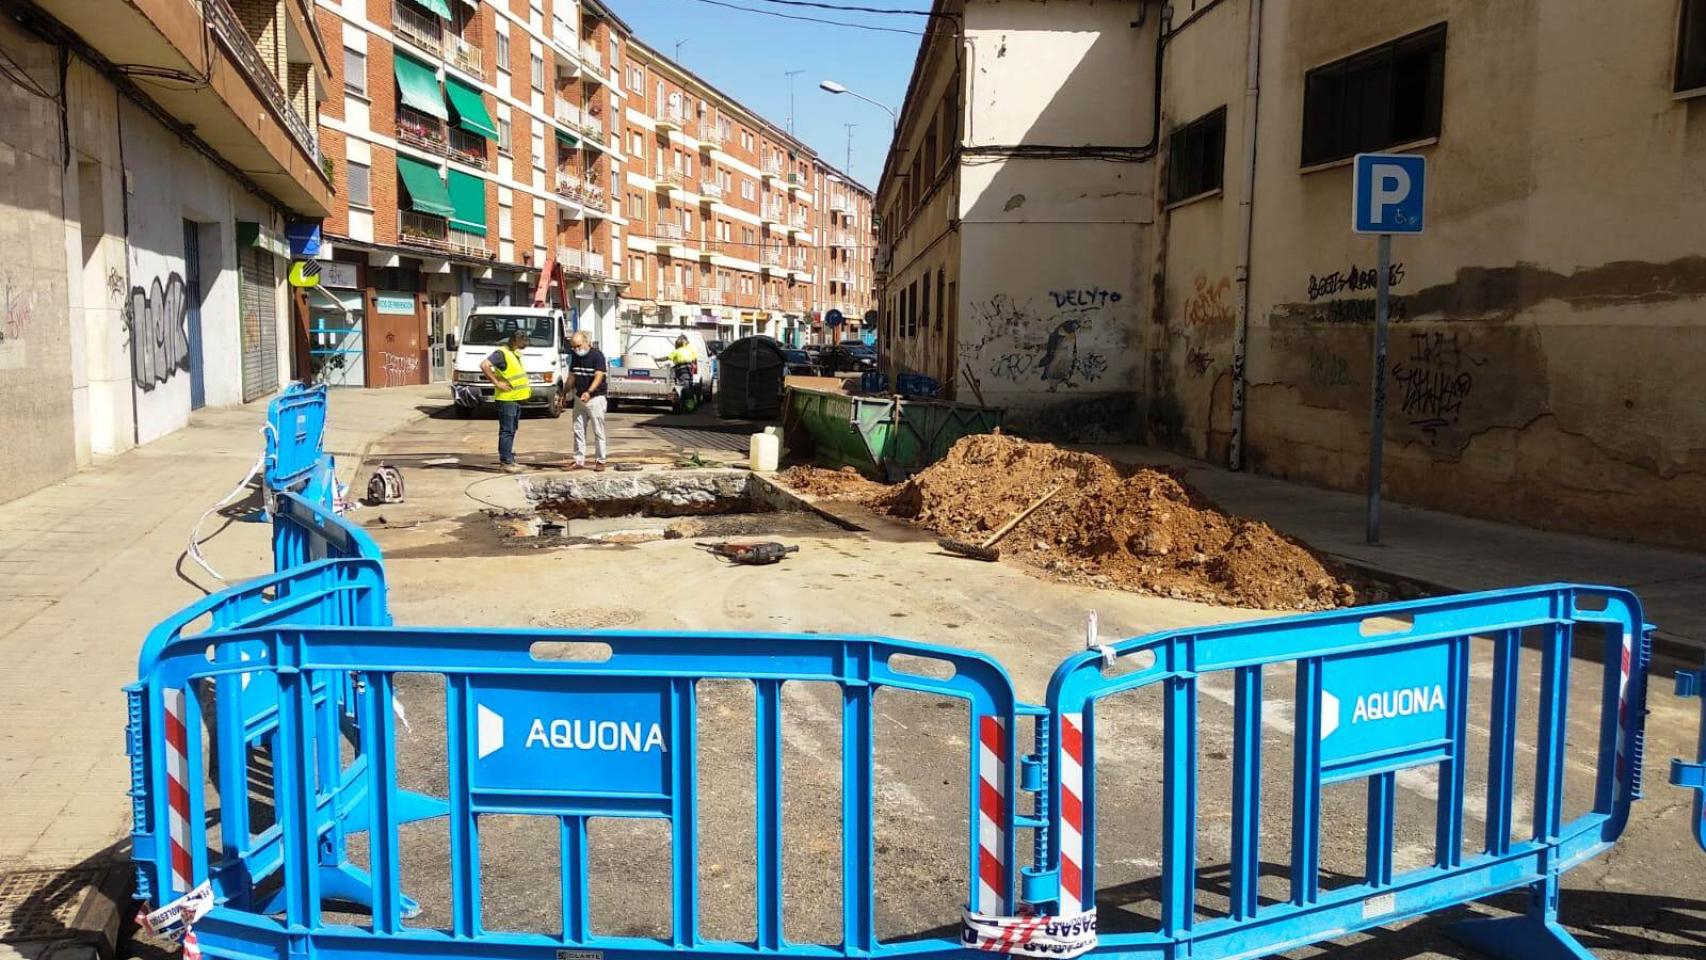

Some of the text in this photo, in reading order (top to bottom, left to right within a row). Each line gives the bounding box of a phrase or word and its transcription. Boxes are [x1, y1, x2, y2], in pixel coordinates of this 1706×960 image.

[1370, 164, 1411, 224] P
[1354, 686, 1445, 722] AQUONA
[526, 719, 668, 752] AQUONA
